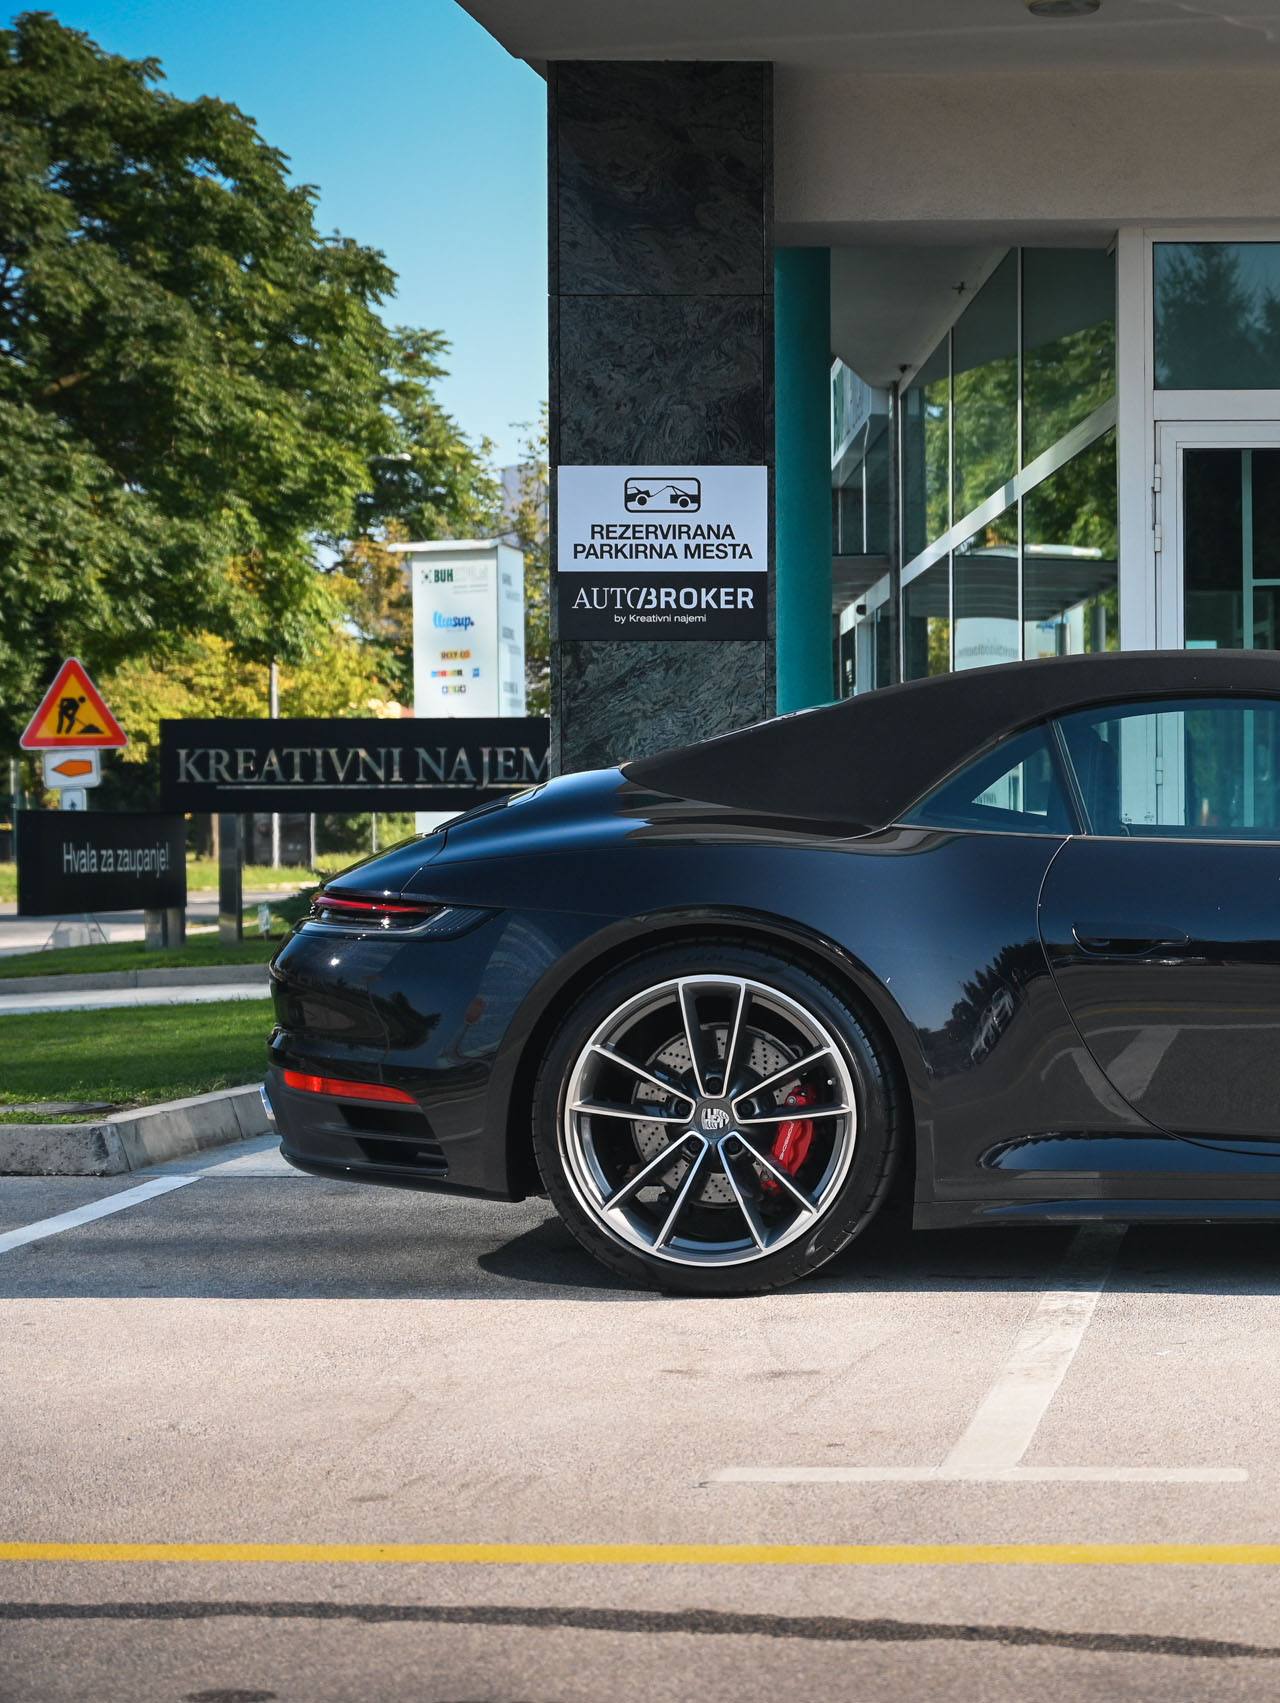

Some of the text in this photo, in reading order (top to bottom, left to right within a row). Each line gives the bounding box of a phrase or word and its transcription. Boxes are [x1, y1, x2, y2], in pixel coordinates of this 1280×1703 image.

[591, 524, 735, 540] REZERVIRANA
[573, 543, 753, 559] PARKIRNA MESTA
[571, 587, 754, 609] AUTOBROKER
[614, 614, 707, 625] by Kreativni najemi
[176, 747, 403, 783] KREATIVNI
[63, 842, 170, 879] Hvala za zaupanje!
